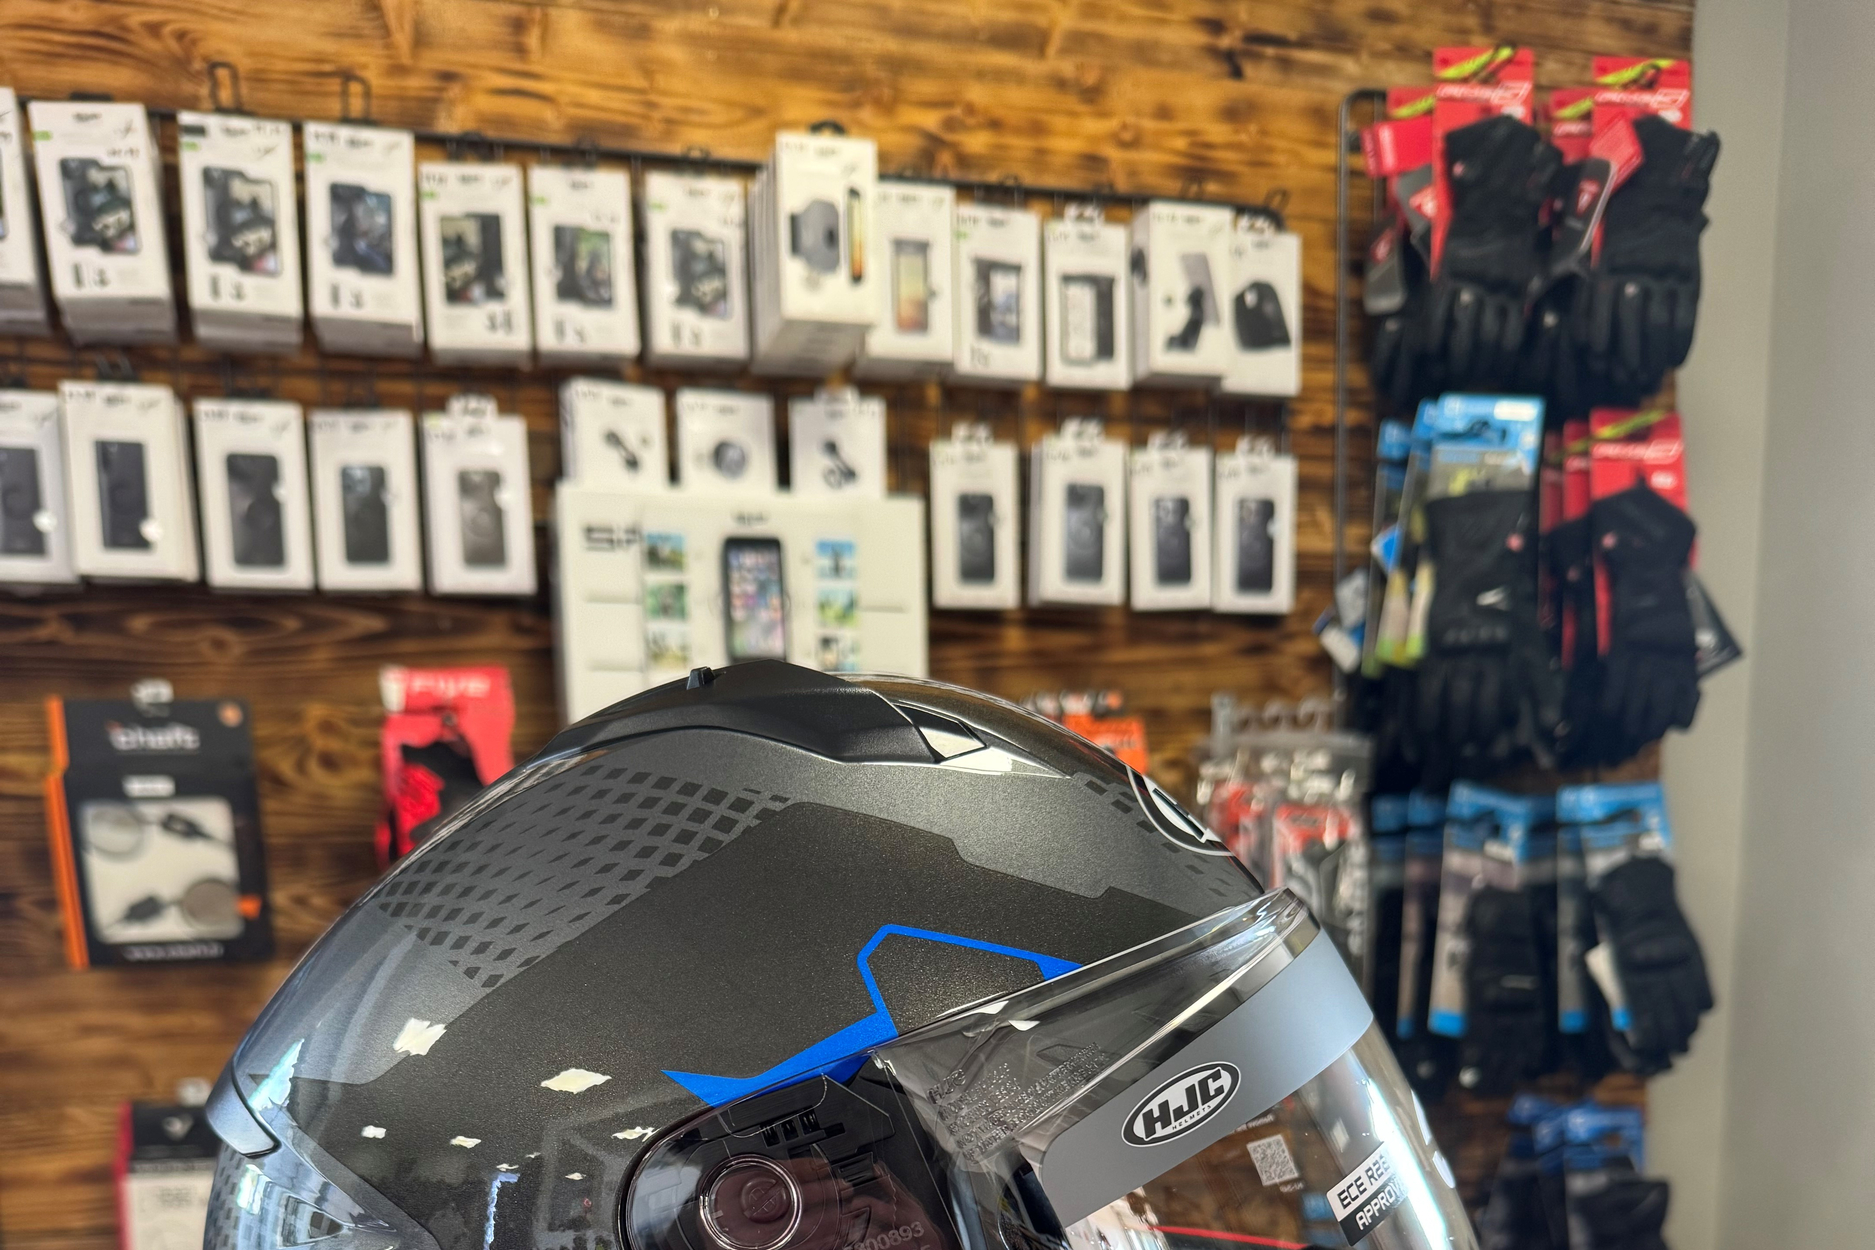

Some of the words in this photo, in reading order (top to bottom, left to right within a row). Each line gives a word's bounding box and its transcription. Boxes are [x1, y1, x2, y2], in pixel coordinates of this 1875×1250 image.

[1141, 1068, 1226, 1140] HJC
[1171, 1105, 1213, 1131] HELMETS
[1337, 1175, 1368, 1210] ECE
